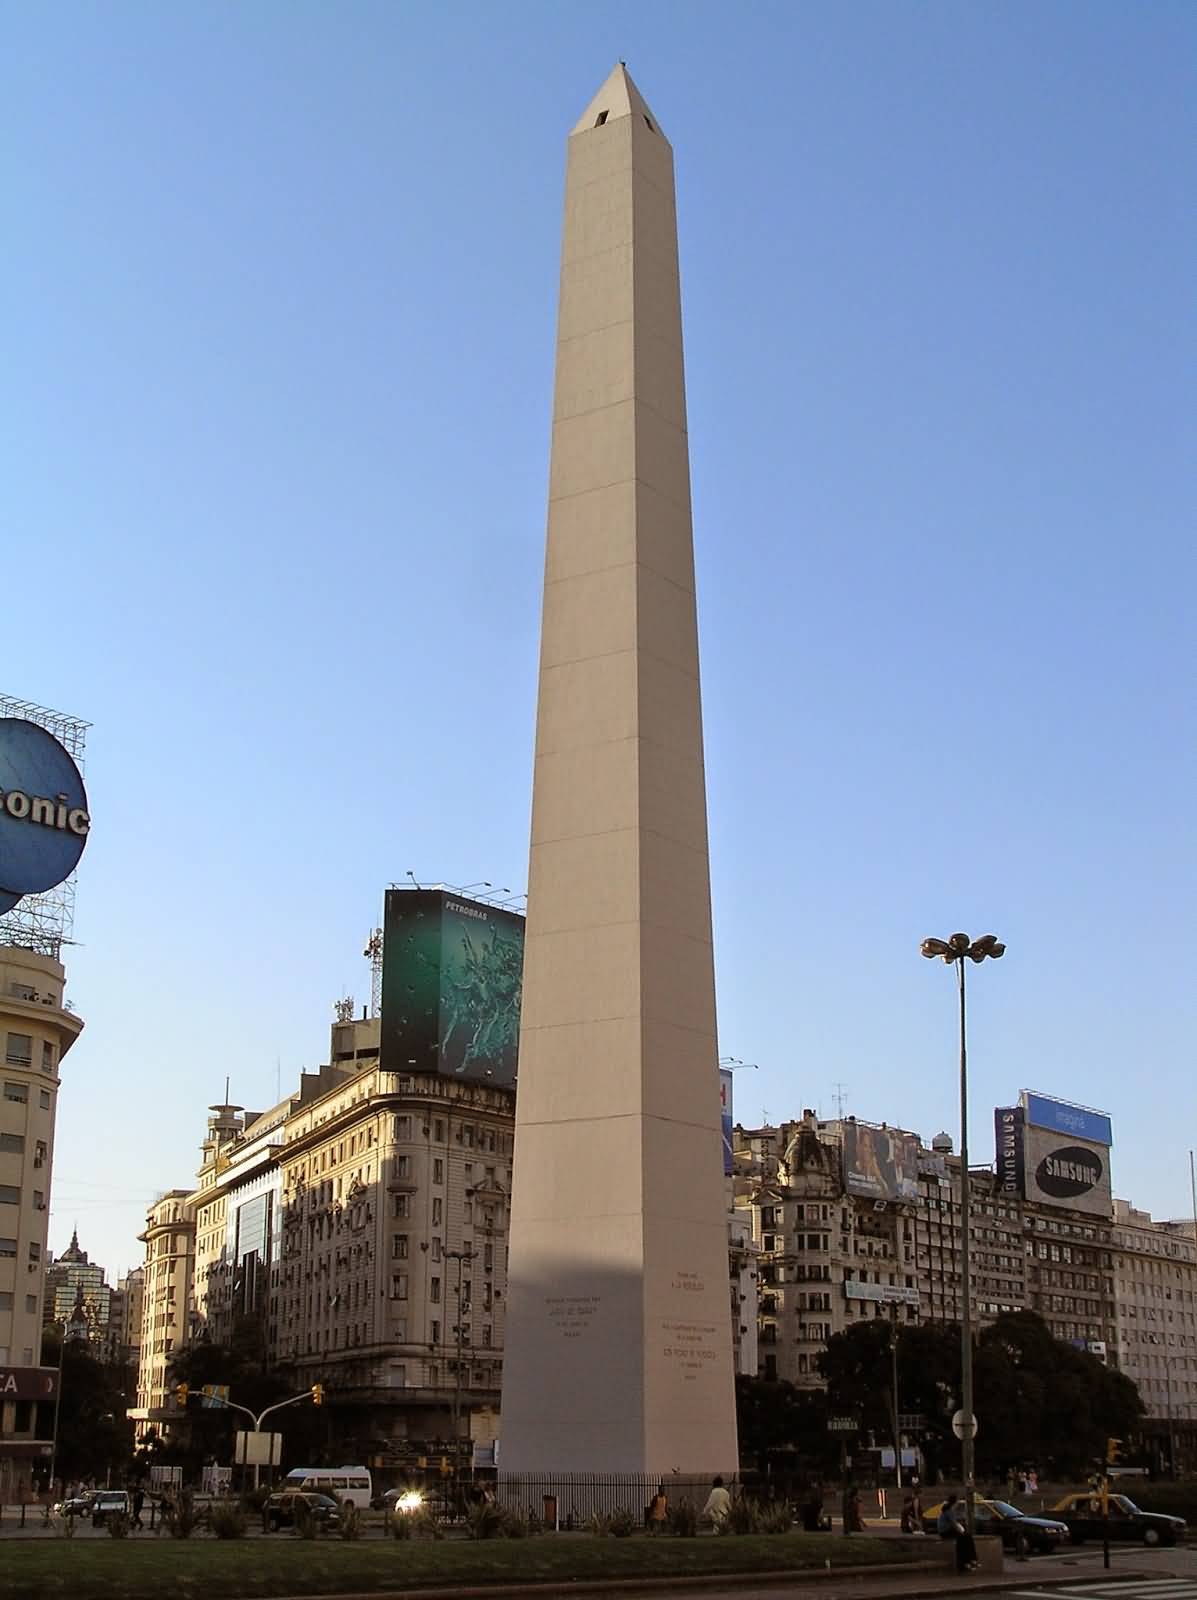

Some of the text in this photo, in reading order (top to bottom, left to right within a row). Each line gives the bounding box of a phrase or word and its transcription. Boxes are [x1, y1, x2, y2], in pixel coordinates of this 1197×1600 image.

[0, 789, 89, 836] onic
[446, 901, 489, 921] PETROBRAS
[1001, 1113, 1017, 1193] SAMSUNG
[1045, 1156, 1097, 1185] SAMSUNG
